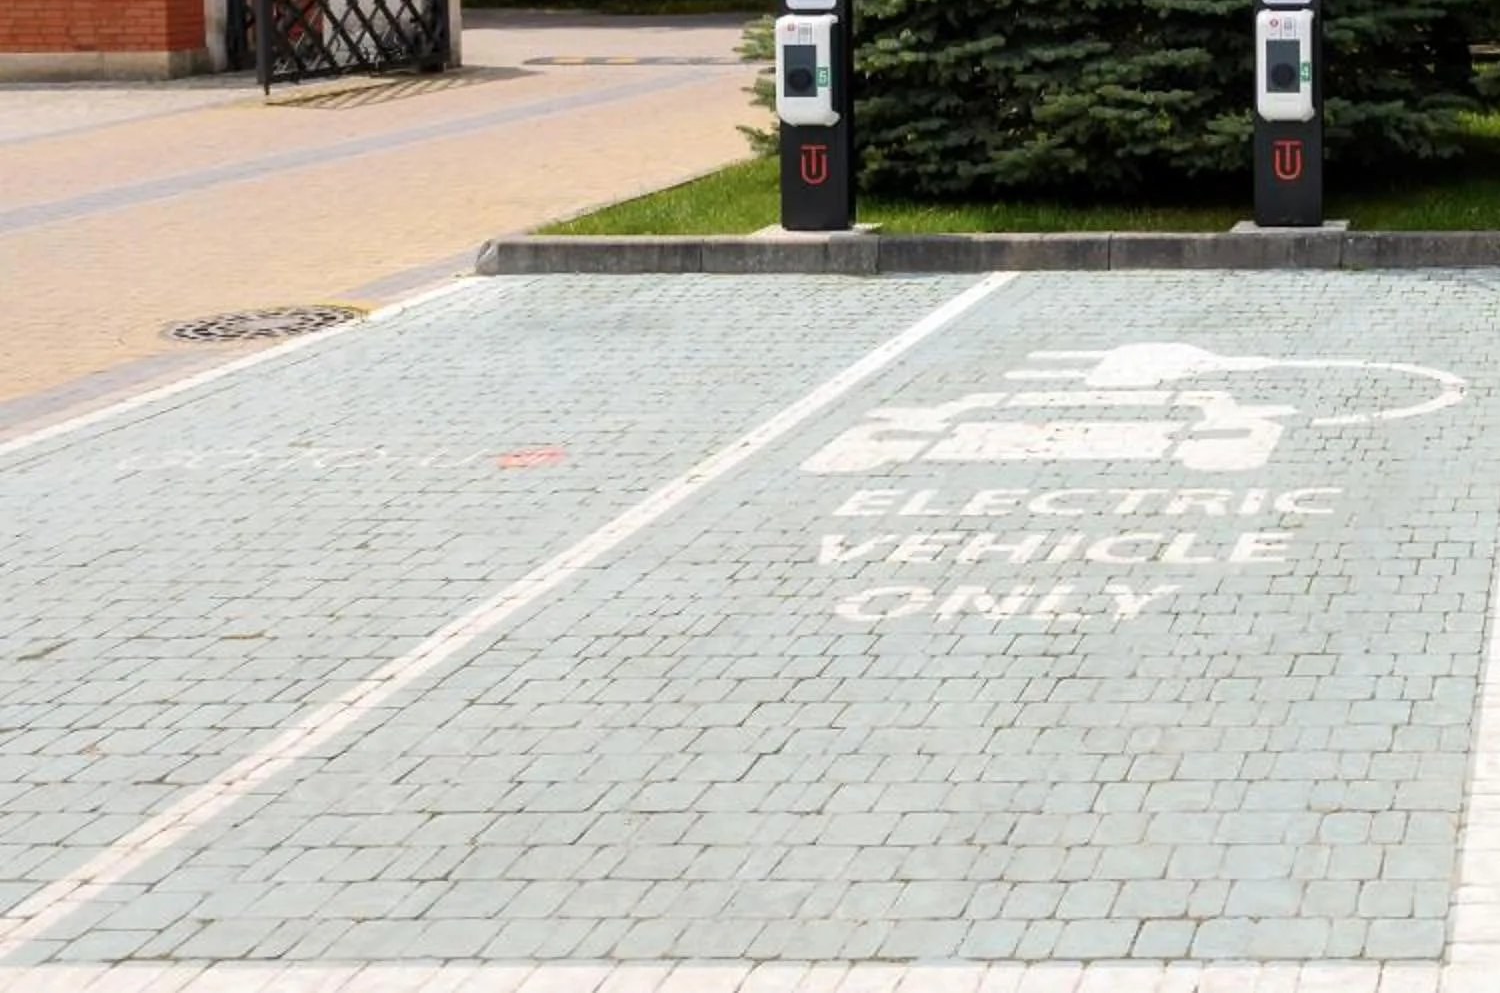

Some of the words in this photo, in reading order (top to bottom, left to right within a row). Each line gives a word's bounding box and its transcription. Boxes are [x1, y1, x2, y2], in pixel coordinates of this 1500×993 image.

[832, 487, 1343, 515] ELECTRIC
[815, 531, 1296, 565] VEHICLE
[833, 583, 1183, 621] ONLY
